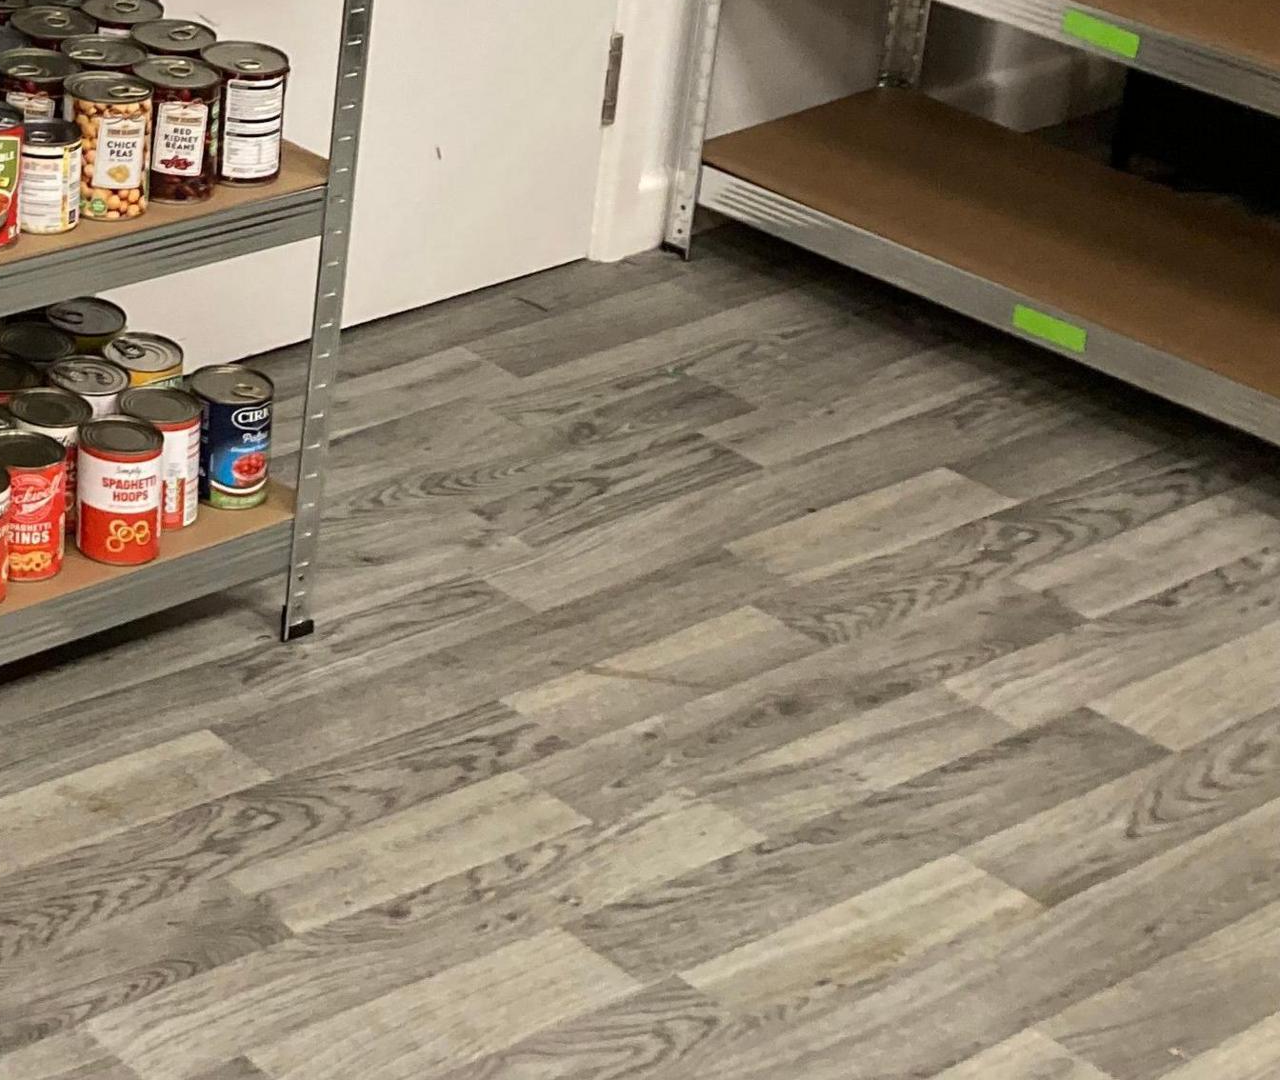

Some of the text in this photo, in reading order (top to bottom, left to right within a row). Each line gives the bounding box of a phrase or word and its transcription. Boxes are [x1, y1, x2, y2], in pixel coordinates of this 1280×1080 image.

[173, 127, 192, 135] RED
[164, 134, 199, 144] KIDNEY
[106, 140, 137, 150] CHICK
[165, 142, 195, 152] BEANS
[109, 149, 133, 159] PEAS
[102, 475, 157, 490] SPAGHETTI
[112, 490, 148, 502] HOOPS
